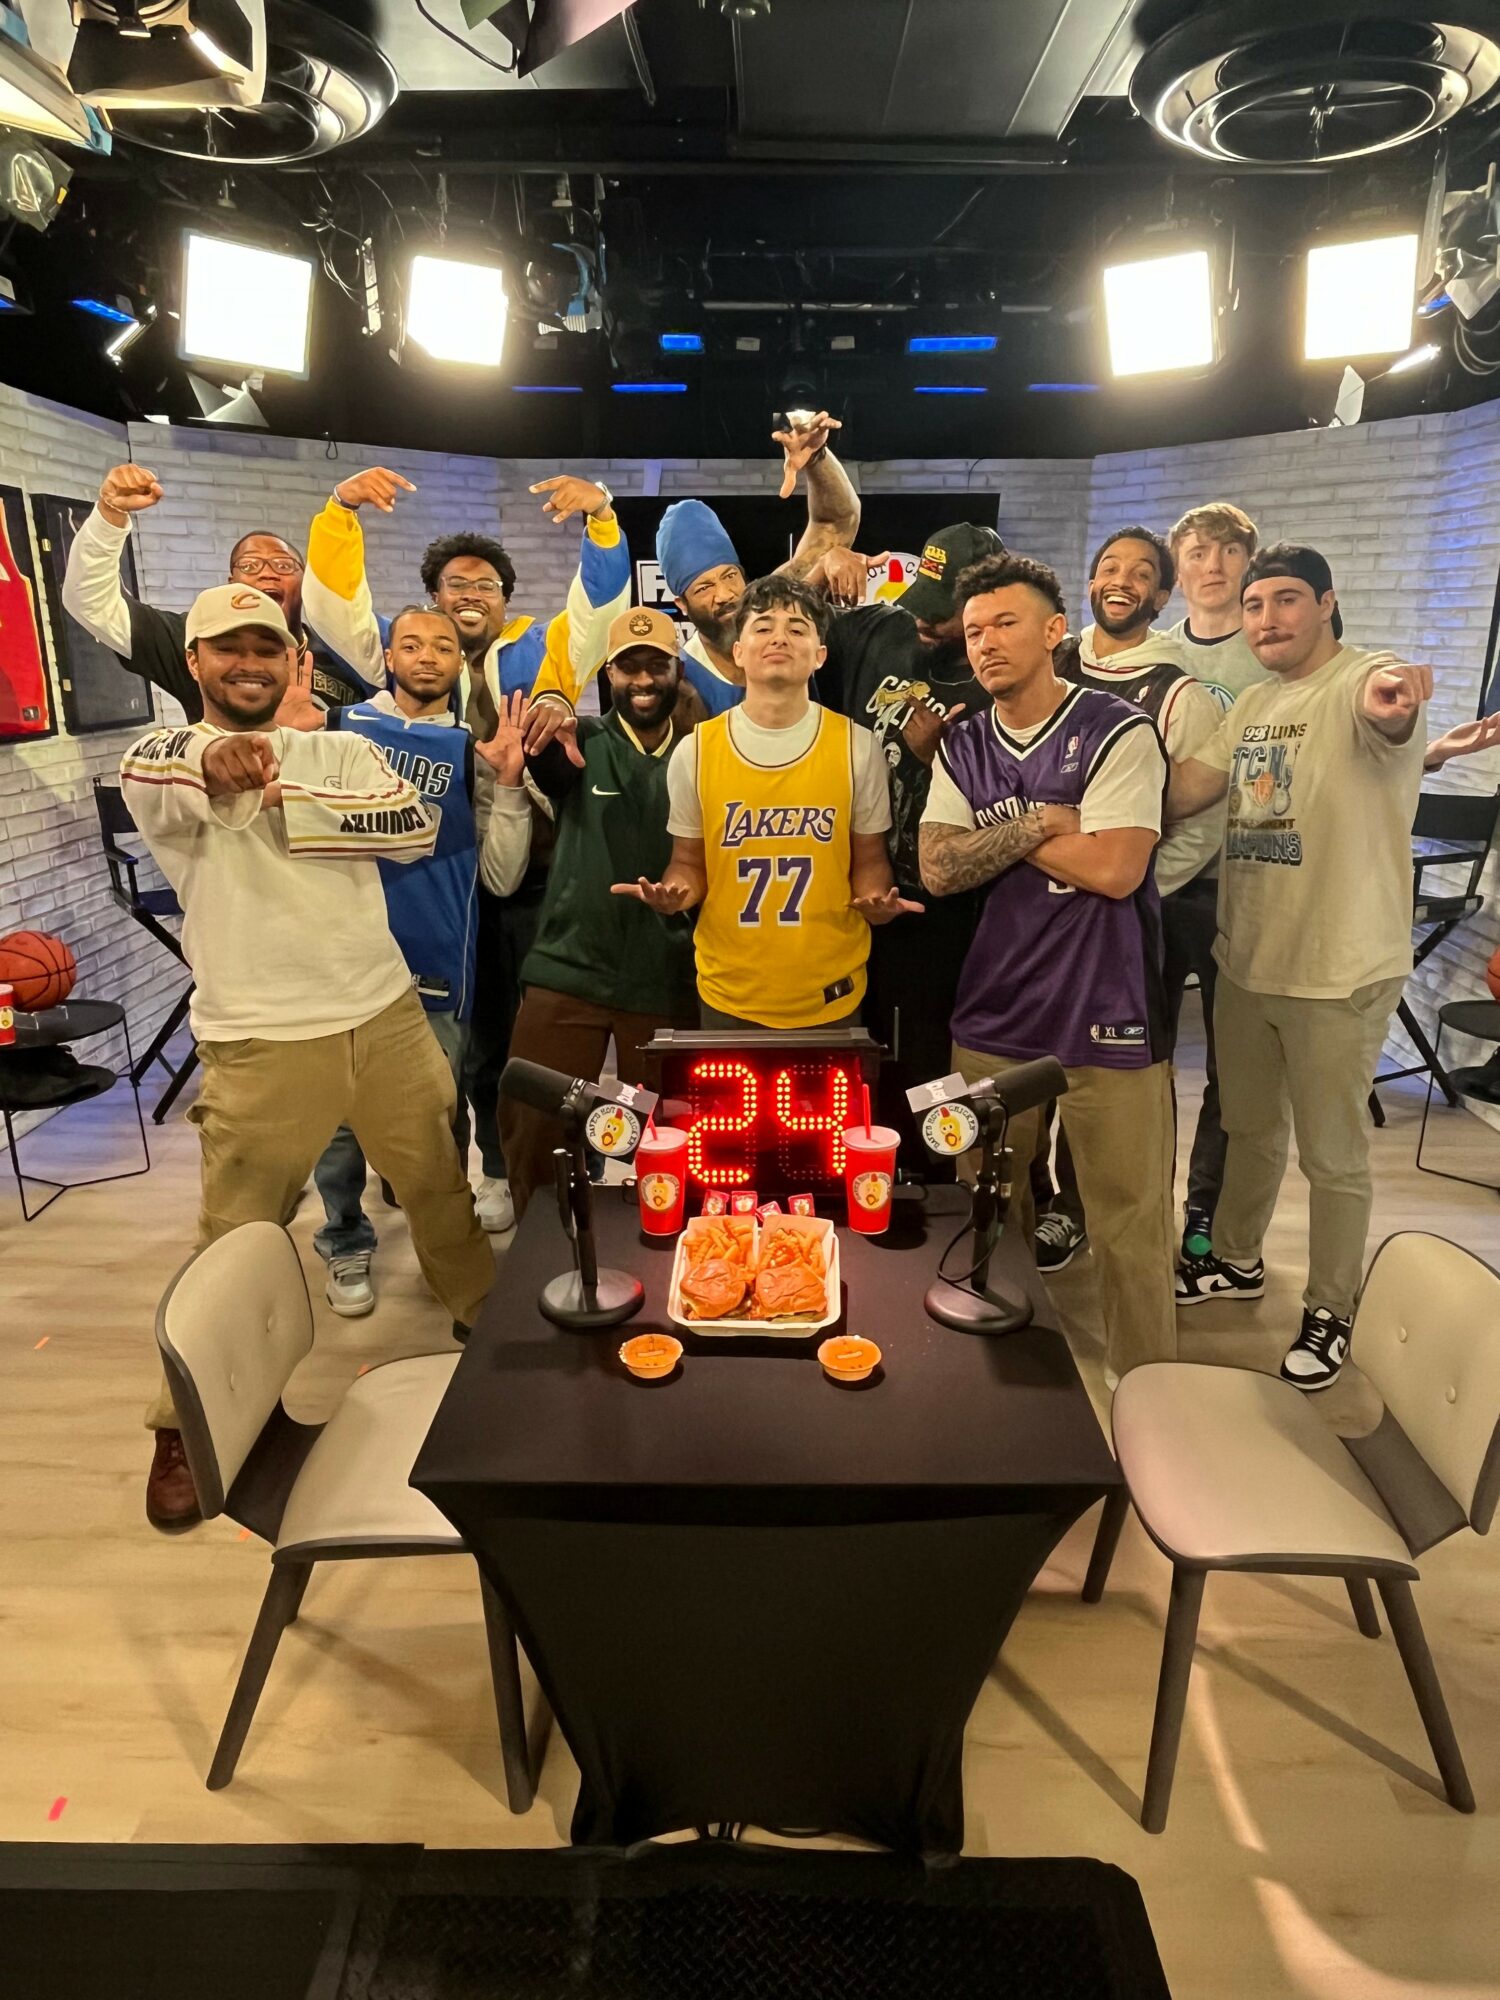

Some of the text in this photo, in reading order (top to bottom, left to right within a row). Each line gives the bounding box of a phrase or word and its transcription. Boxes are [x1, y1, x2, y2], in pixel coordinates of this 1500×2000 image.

[340, 805, 426, 834] COUNTRY
[720, 801, 836, 848] LAKERS
[737, 856, 814, 927] 77
[1105, 1027, 1117, 1038] XL
[688, 1063, 848, 1183] 24
